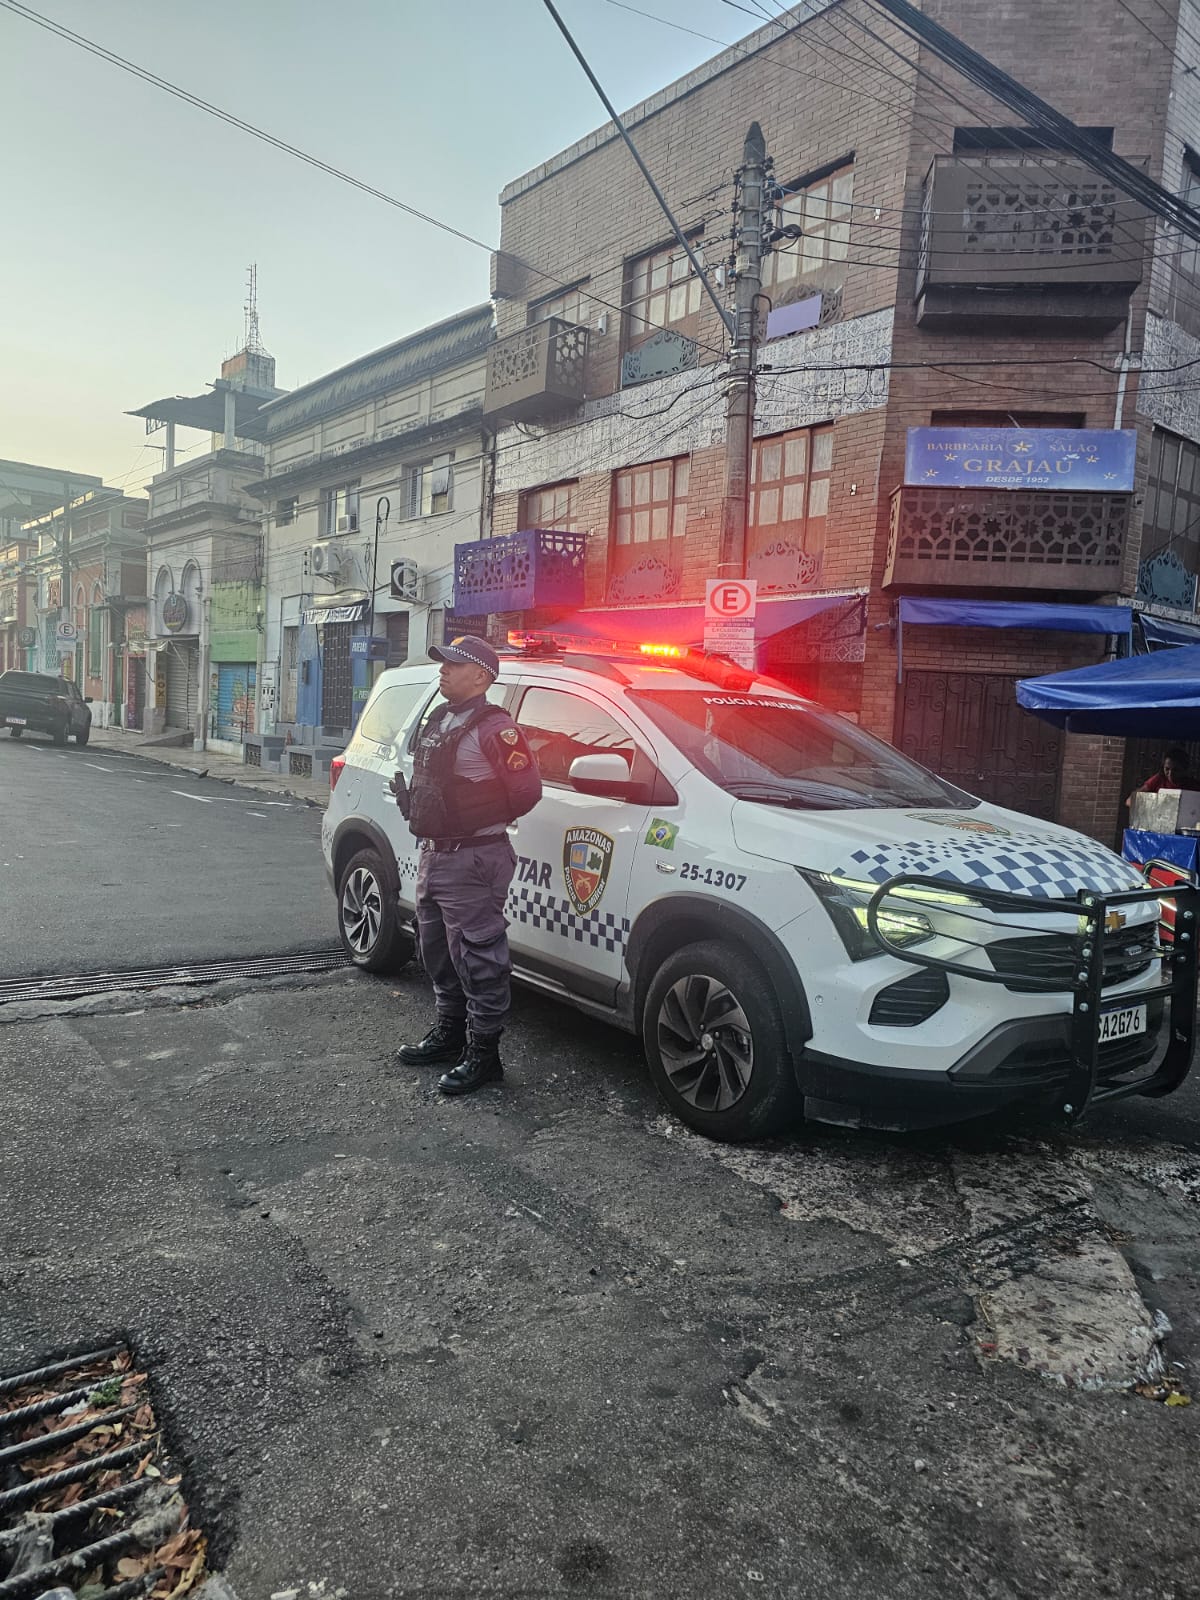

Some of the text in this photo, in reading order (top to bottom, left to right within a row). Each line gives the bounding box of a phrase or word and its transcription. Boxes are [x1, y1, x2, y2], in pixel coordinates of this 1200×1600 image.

[927, 442, 1003, 451] BARBEARIA
[985, 476, 1023, 484] DESDE
[722, 589, 739, 610] E
[63, 625, 70, 634] E
[566, 829, 612, 854] AMAZONAS
[516, 855, 552, 890] TAR
[680, 862, 747, 892] 25-1307
[588, 878, 606, 909] Militar
